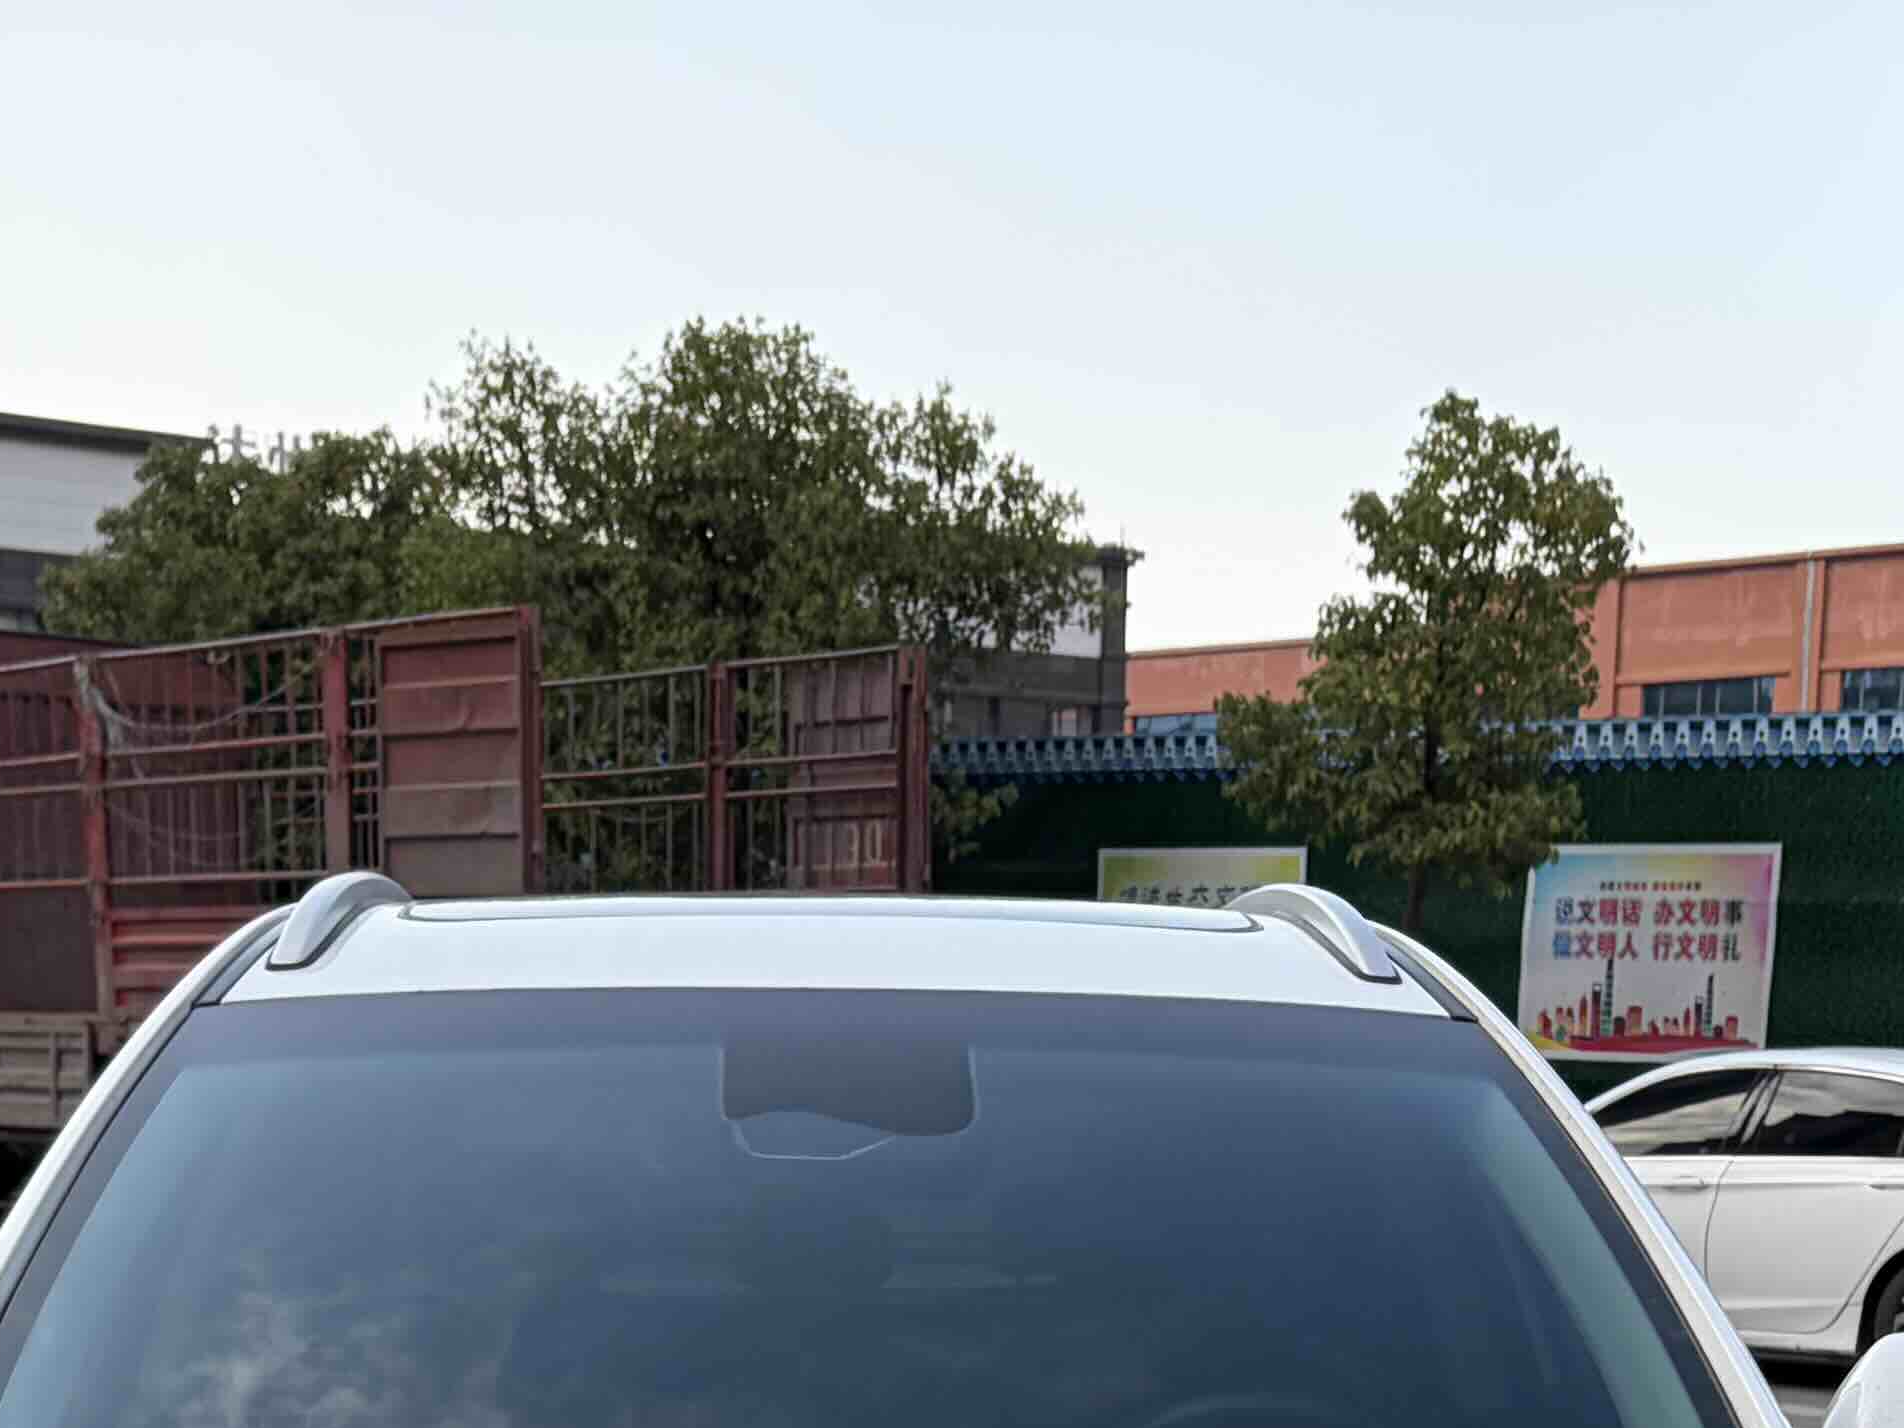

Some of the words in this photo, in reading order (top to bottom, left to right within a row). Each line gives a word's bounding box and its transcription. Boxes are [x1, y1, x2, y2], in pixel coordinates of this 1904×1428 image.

[1653, 898, 1744, 925] 办文明事
[1652, 931, 1743, 961] 行文明礼
